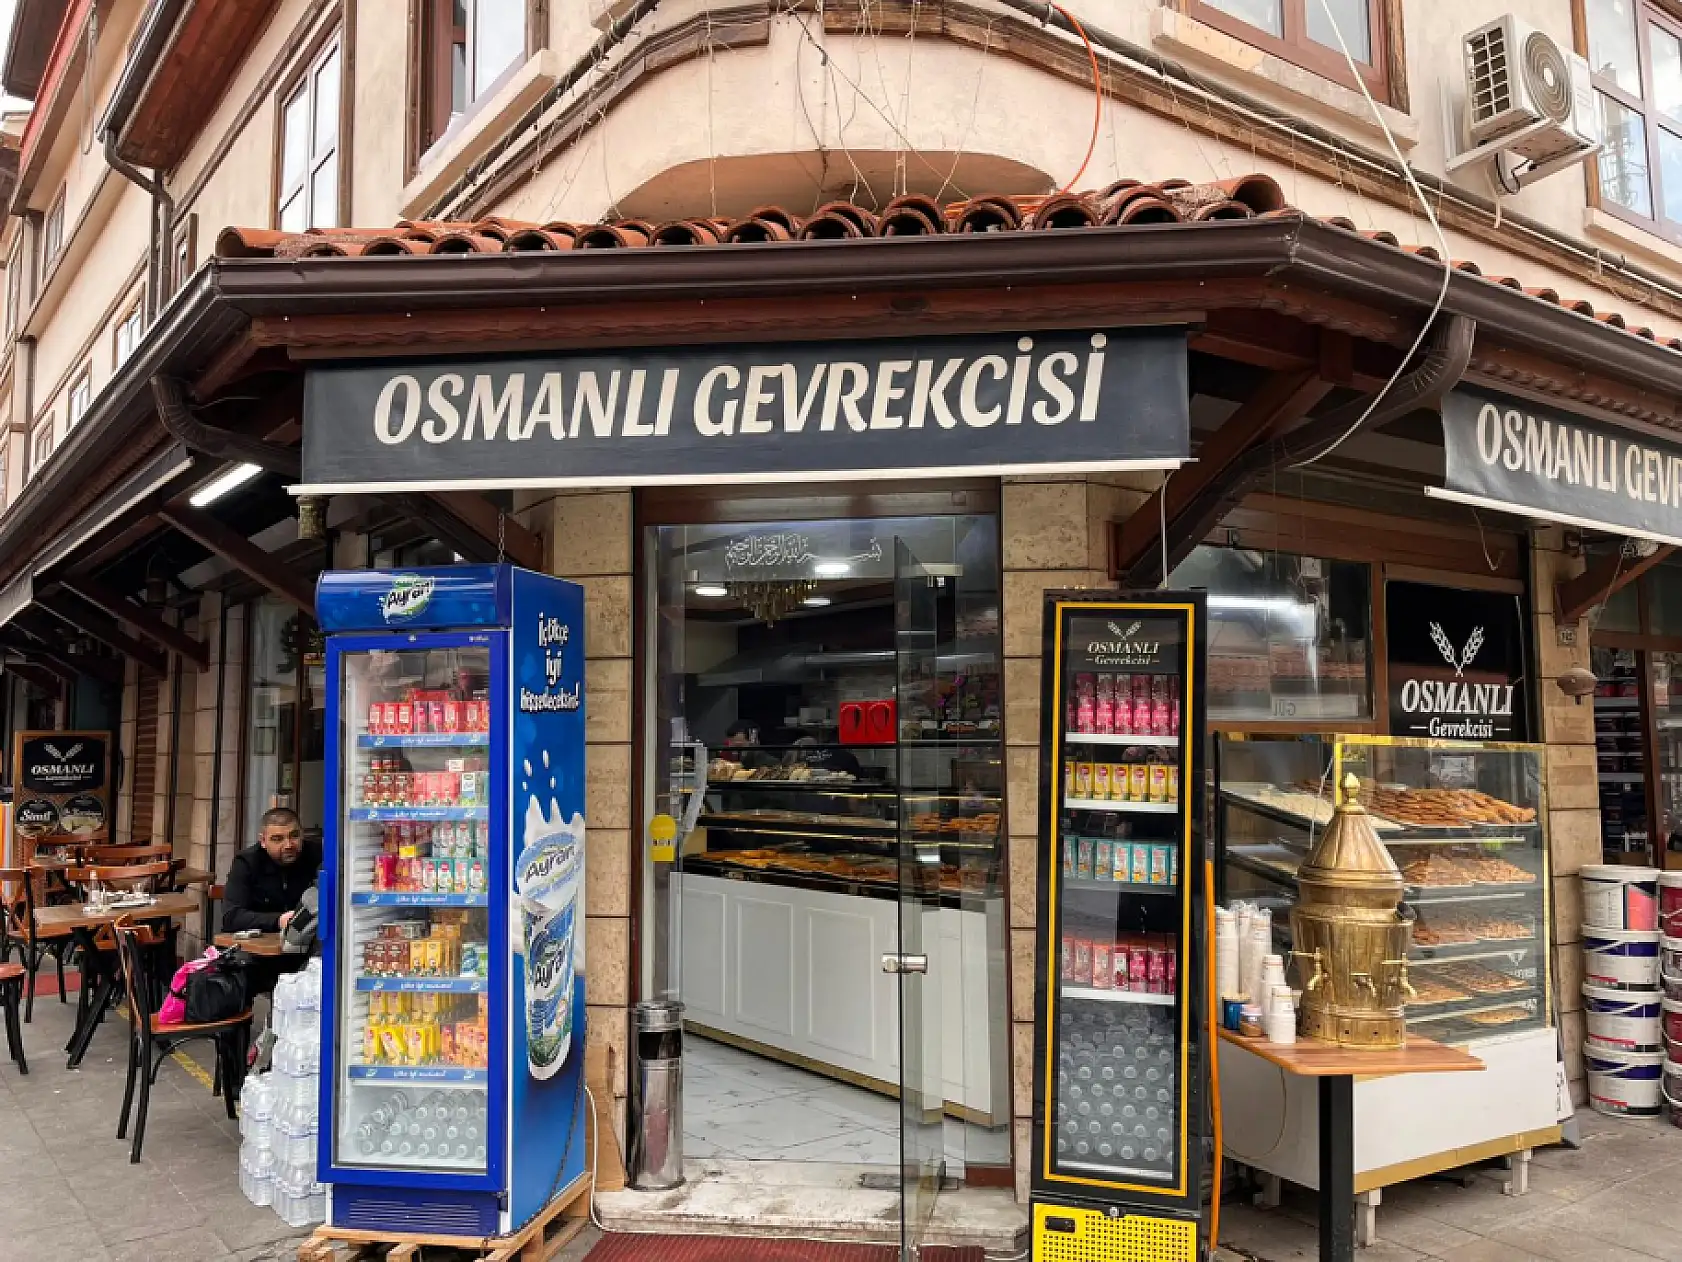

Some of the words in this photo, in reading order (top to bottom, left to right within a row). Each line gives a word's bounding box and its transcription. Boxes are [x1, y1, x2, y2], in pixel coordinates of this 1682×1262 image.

[374, 368, 680, 445] OSMANLI
[693, 333, 1107, 437] GEVREKCİSİ
[1477, 403, 1617, 493] OSMANLI
[1087, 641, 1160, 653] OSMANLI
[1401, 679, 1514, 716] OSMANLI
[1429, 717, 1494, 737] Gevrekcisi
[30, 764, 94, 775] OSMANLI
[525, 844, 576, 883] Ayran
